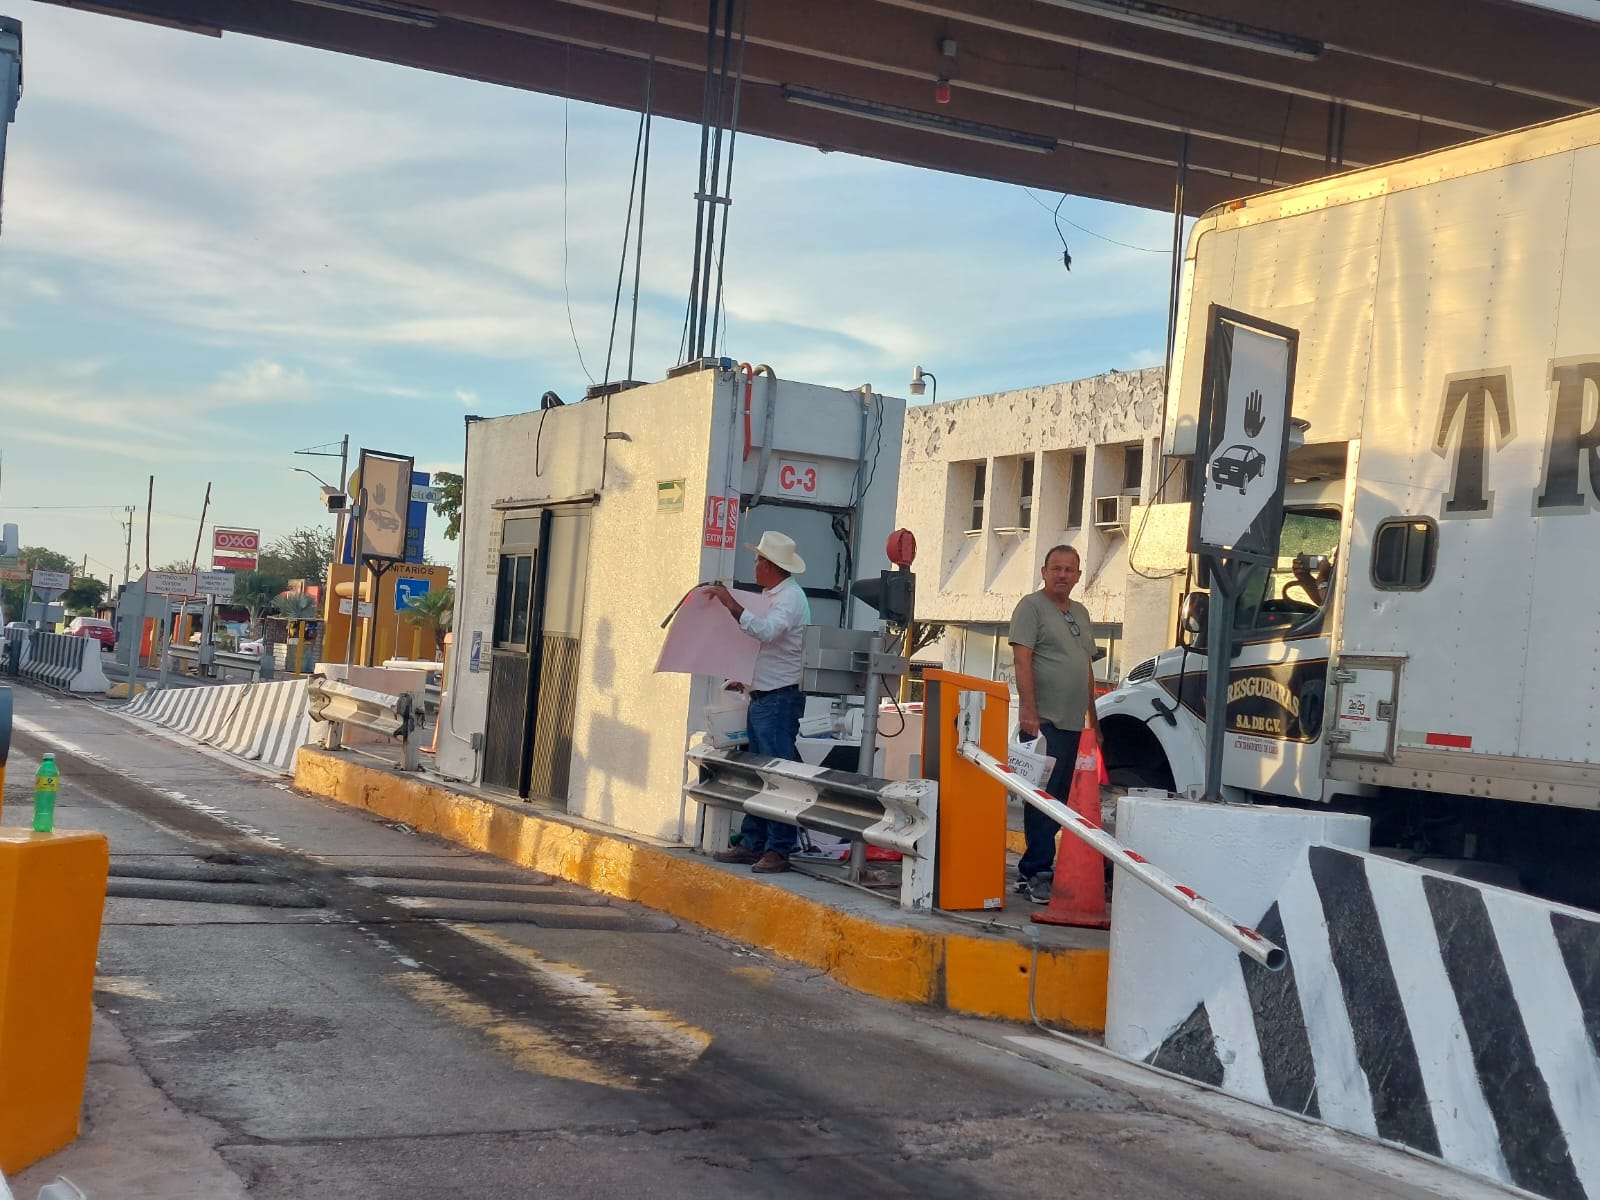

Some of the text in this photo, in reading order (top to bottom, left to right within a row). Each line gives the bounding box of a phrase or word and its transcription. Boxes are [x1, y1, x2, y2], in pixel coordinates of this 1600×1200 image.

[780, 465, 817, 493] C-3
[218, 534, 256, 548] OXXO
[706, 533, 734, 544] EXTINOR
[1226, 677, 1299, 717] RESGUERRAS
[1236, 714, 1251, 729] S.A.
[1252, 715, 1265, 731] DE
